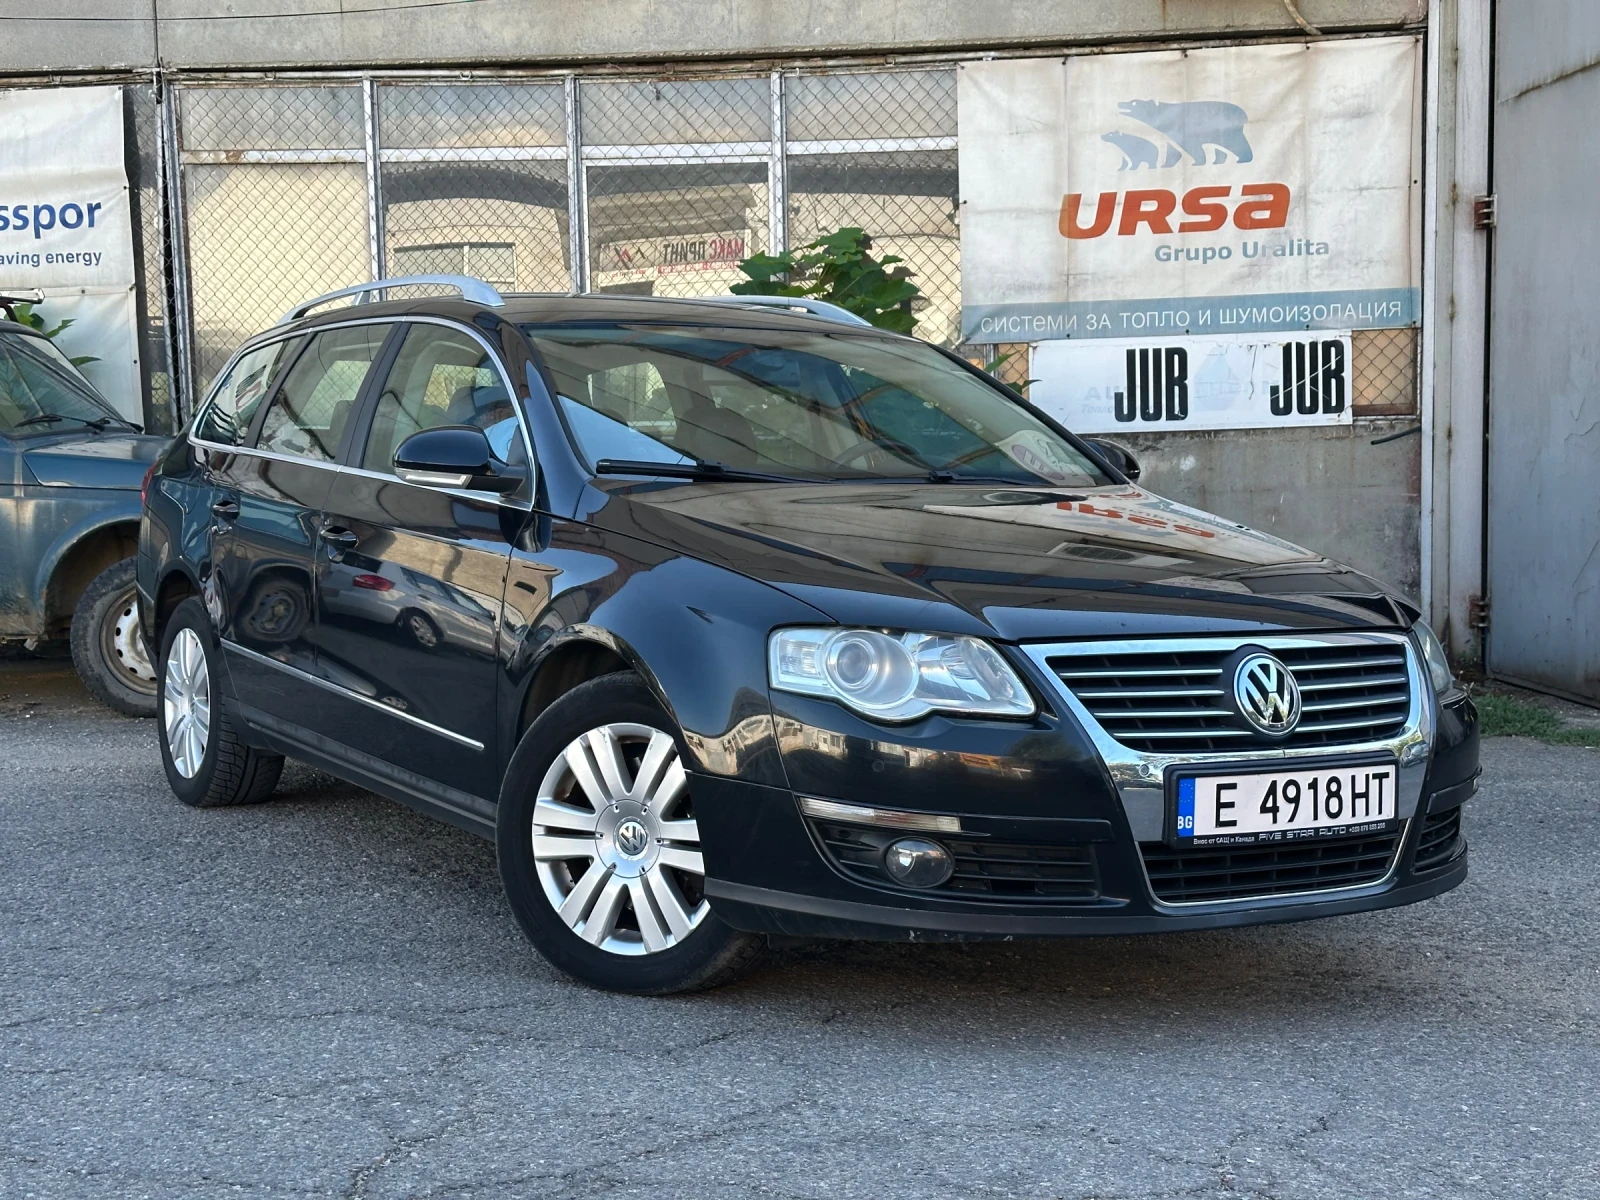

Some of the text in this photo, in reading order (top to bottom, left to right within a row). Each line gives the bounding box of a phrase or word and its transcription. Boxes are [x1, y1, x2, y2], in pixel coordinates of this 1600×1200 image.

[0, 202, 102, 239] sspor
[0, 252, 102, 267] aving energy
[1154, 239, 1329, 264] Grupo Uralita
[1086, 313, 1112, 330] ЗА
[1124, 310, 1190, 329] ТОПЛО
[1199, 309, 1211, 325] И
[1219, 301, 1402, 325] ШУМОИЗОЛАЦИЯ
[1114, 347, 1189, 422] JUB
[1270, 339, 1345, 416] JUB
[1215, 771, 1390, 828] E 4918HT
[1177, 815, 1193, 830] BG
[1258, 831, 1282, 841] FIVE
[1286, 829, 1315, 839] STAR
[1319, 826, 1347, 836] AUTO
